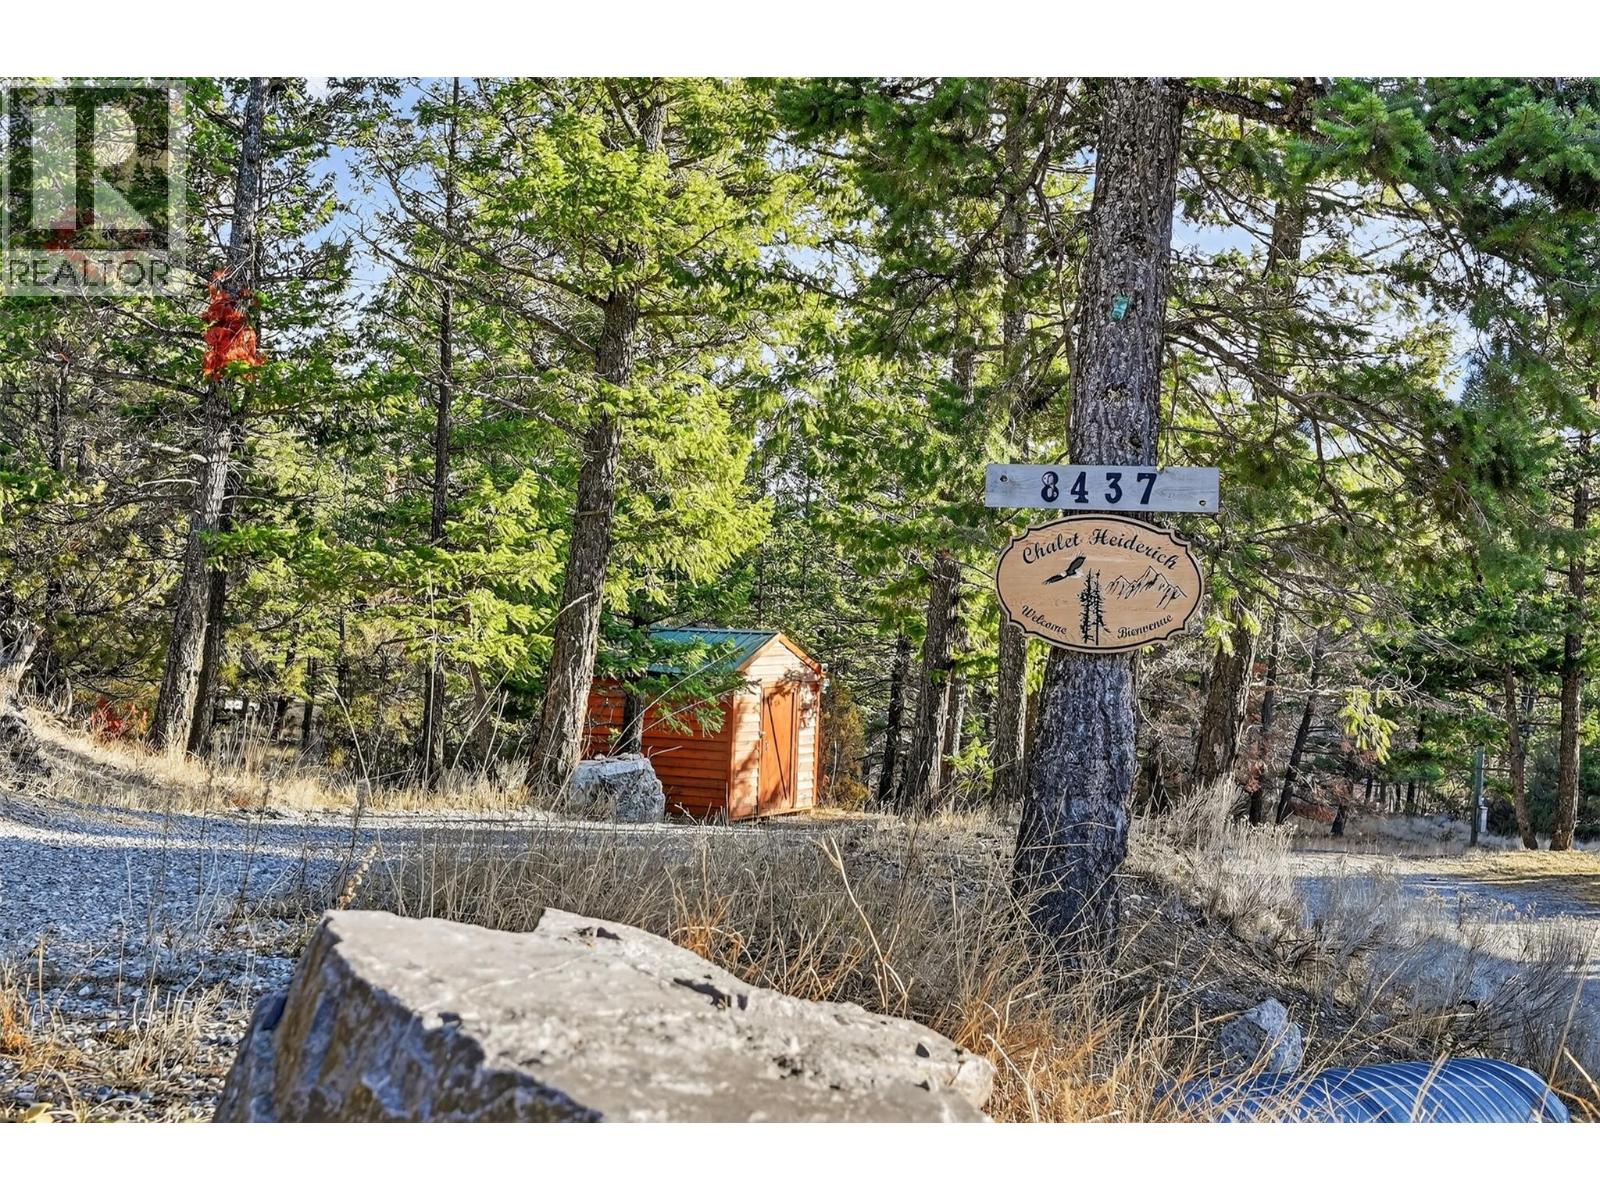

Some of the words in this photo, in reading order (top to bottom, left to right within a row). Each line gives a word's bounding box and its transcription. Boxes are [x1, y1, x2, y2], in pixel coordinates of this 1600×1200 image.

[1041, 471, 1157, 505] 8437
[1023, 532, 1080, 564] Chalet
[1088, 528, 1180, 570] Heiderich
[1021, 605, 1068, 635] Welcome
[1117, 614, 1174, 639] Bienvenue
